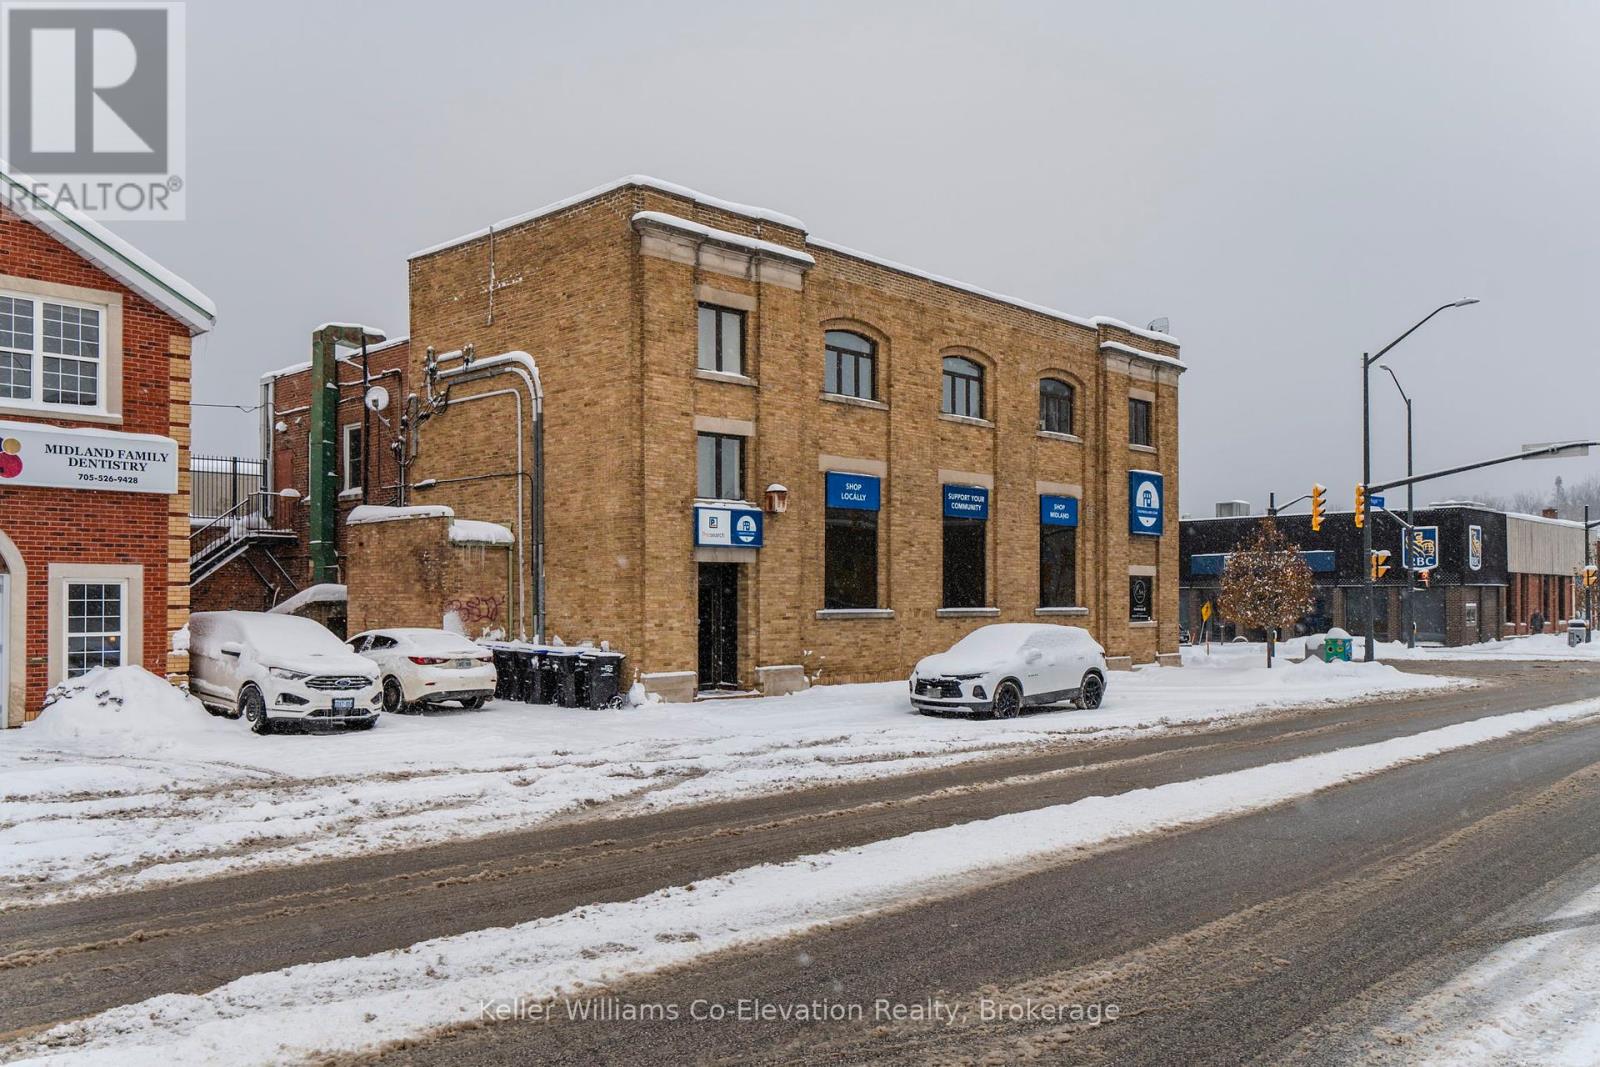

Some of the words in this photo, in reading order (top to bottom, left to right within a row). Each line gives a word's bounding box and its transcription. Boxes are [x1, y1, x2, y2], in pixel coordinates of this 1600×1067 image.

[45, 444, 114, 459] MIDLAND
[118, 449, 169, 463] FAMILY
[68, 457, 148, 472] DENTISTRY
[78, 474, 138, 484] 705-526-9428
[845, 482, 862, 491] SHOP
[841, 492, 867, 501] LOCALLY
[948, 492, 970, 502] SUPPORT
[971, 495, 985, 503] YOUR
[951, 502, 982, 511] COMMUNITY
[1053, 503, 1066, 511] SHOP
[1049, 511, 1070, 519] MIDLAND
